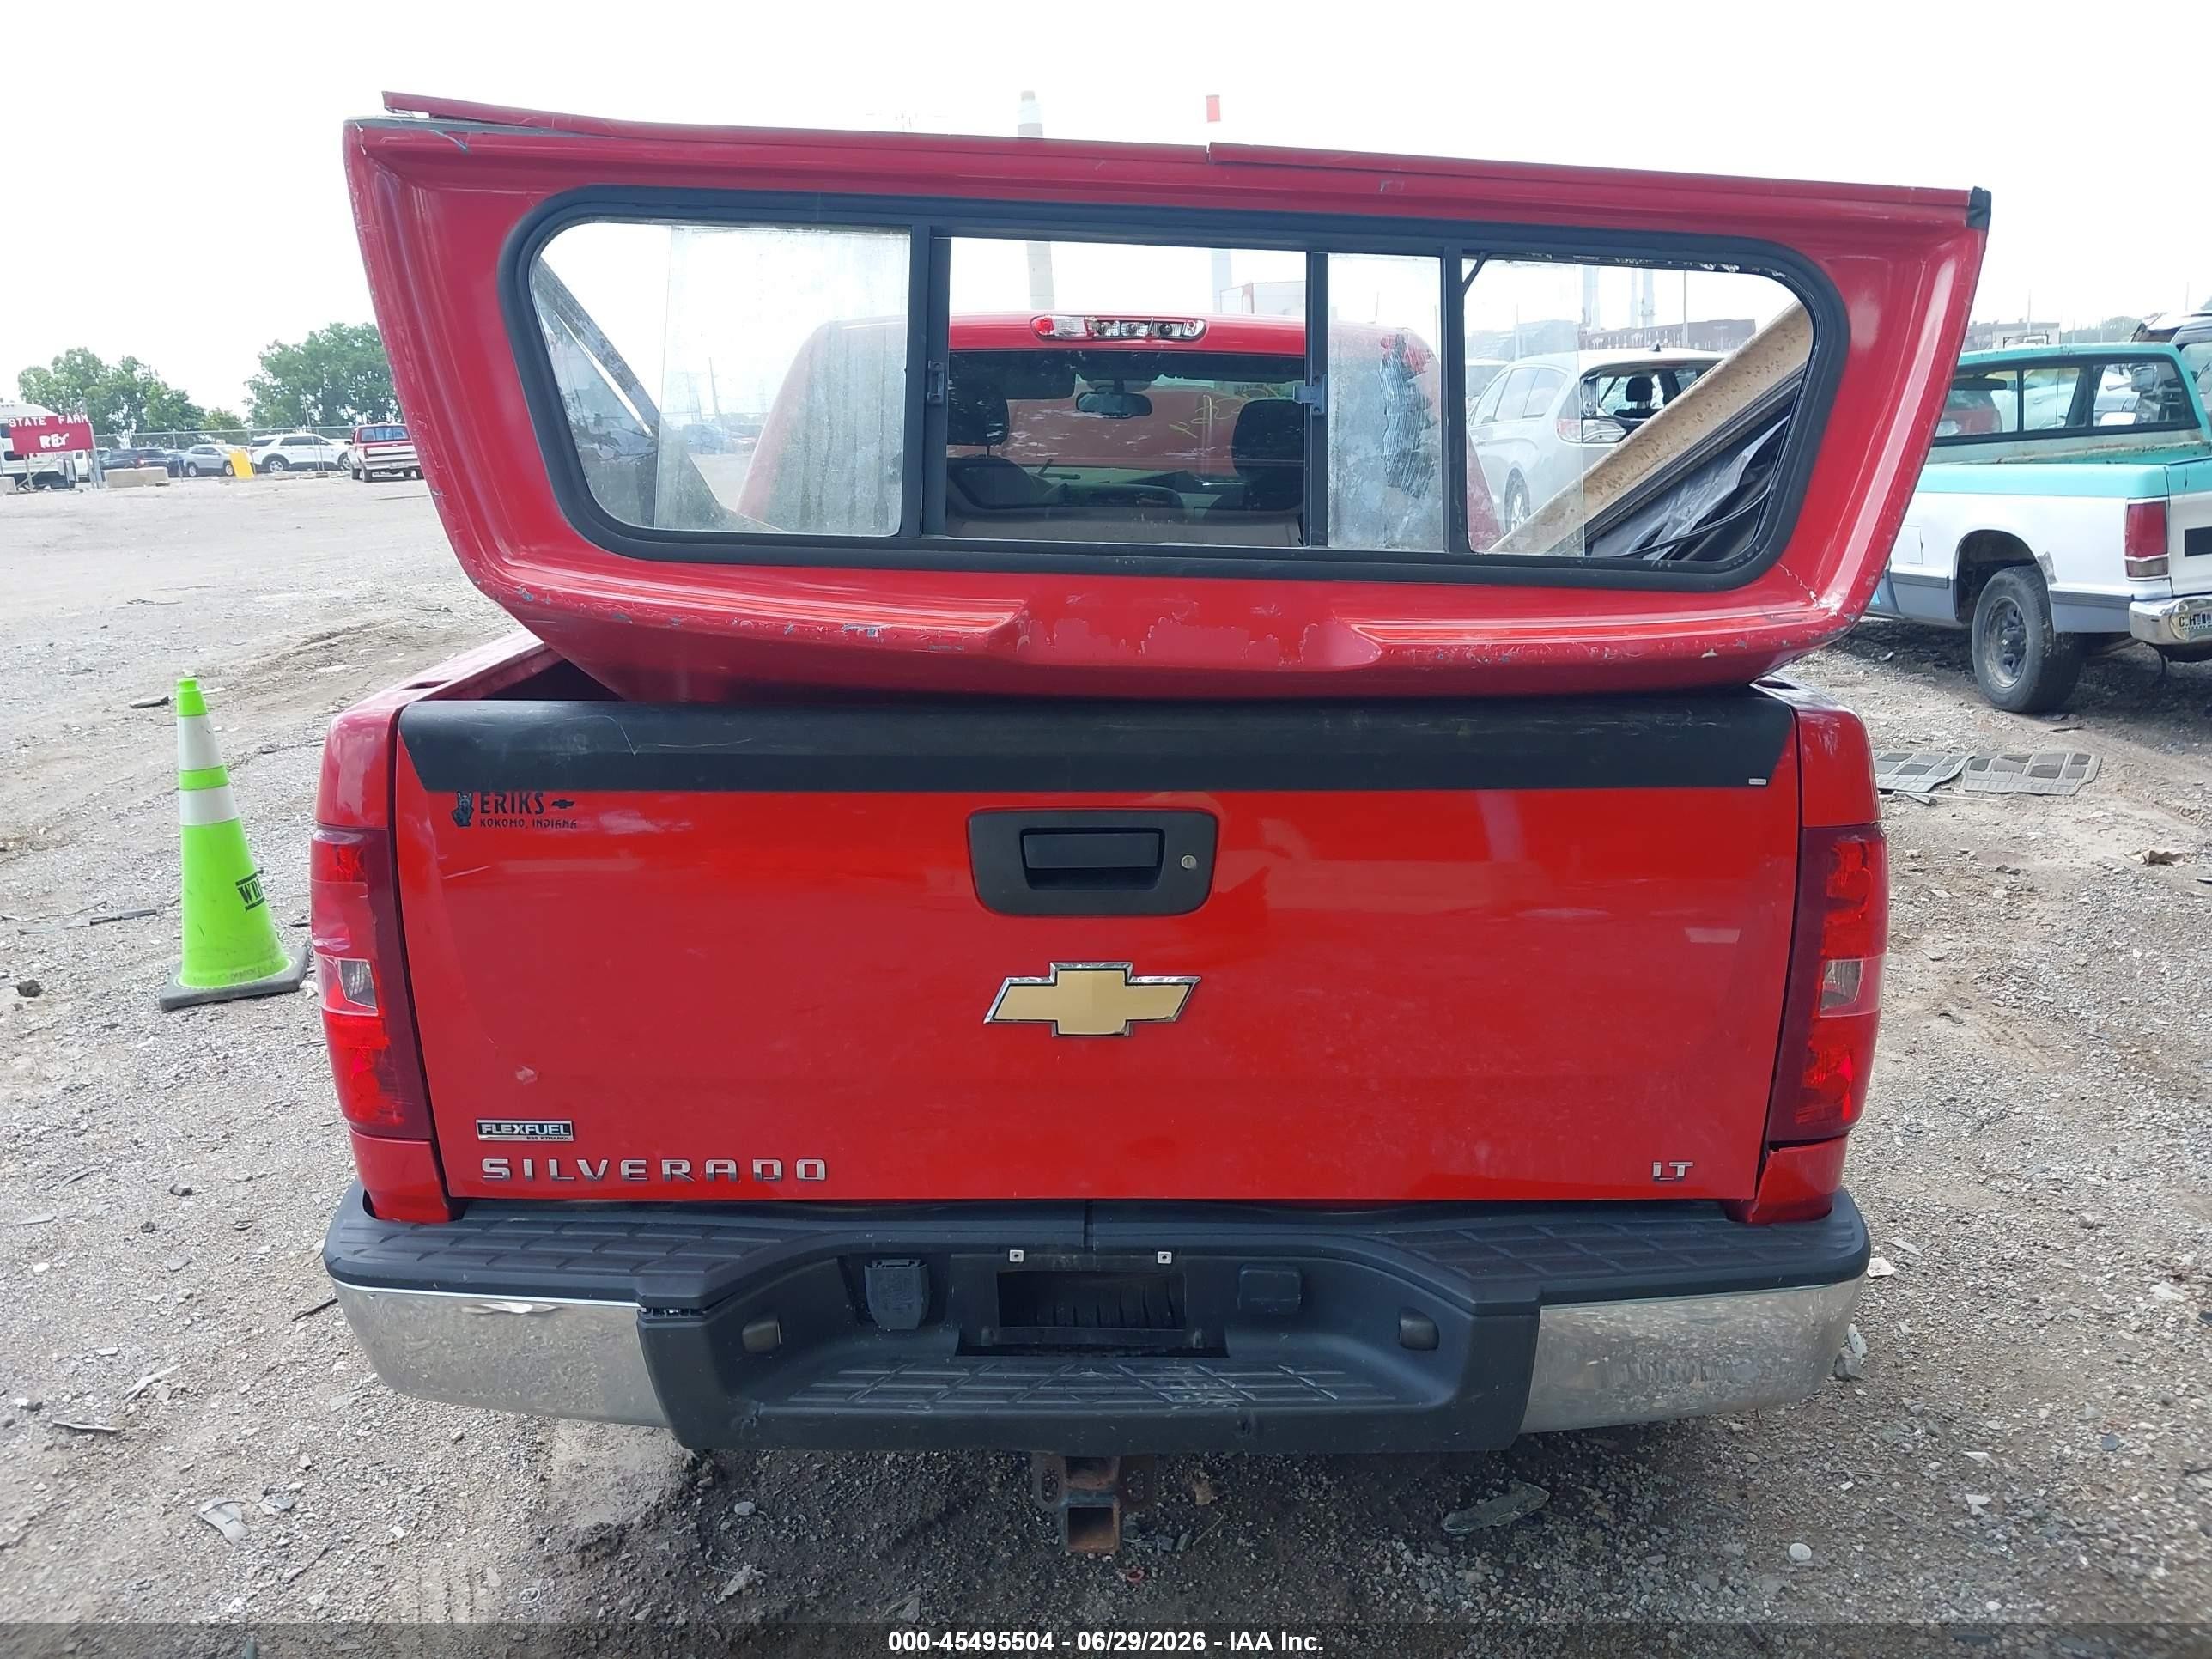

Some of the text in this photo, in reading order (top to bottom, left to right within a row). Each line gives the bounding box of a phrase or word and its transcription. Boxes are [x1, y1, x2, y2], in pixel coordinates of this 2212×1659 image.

[9, 413, 88, 428] STATE FARM
[480, 792, 544, 815] ERIKS
[532, 818, 577, 829] INDIANA
[481, 1124, 569, 1134] FLEXFUEL
[481, 1158, 827, 1182] SILVERADO
[1653, 1161, 1693, 1181] LT
